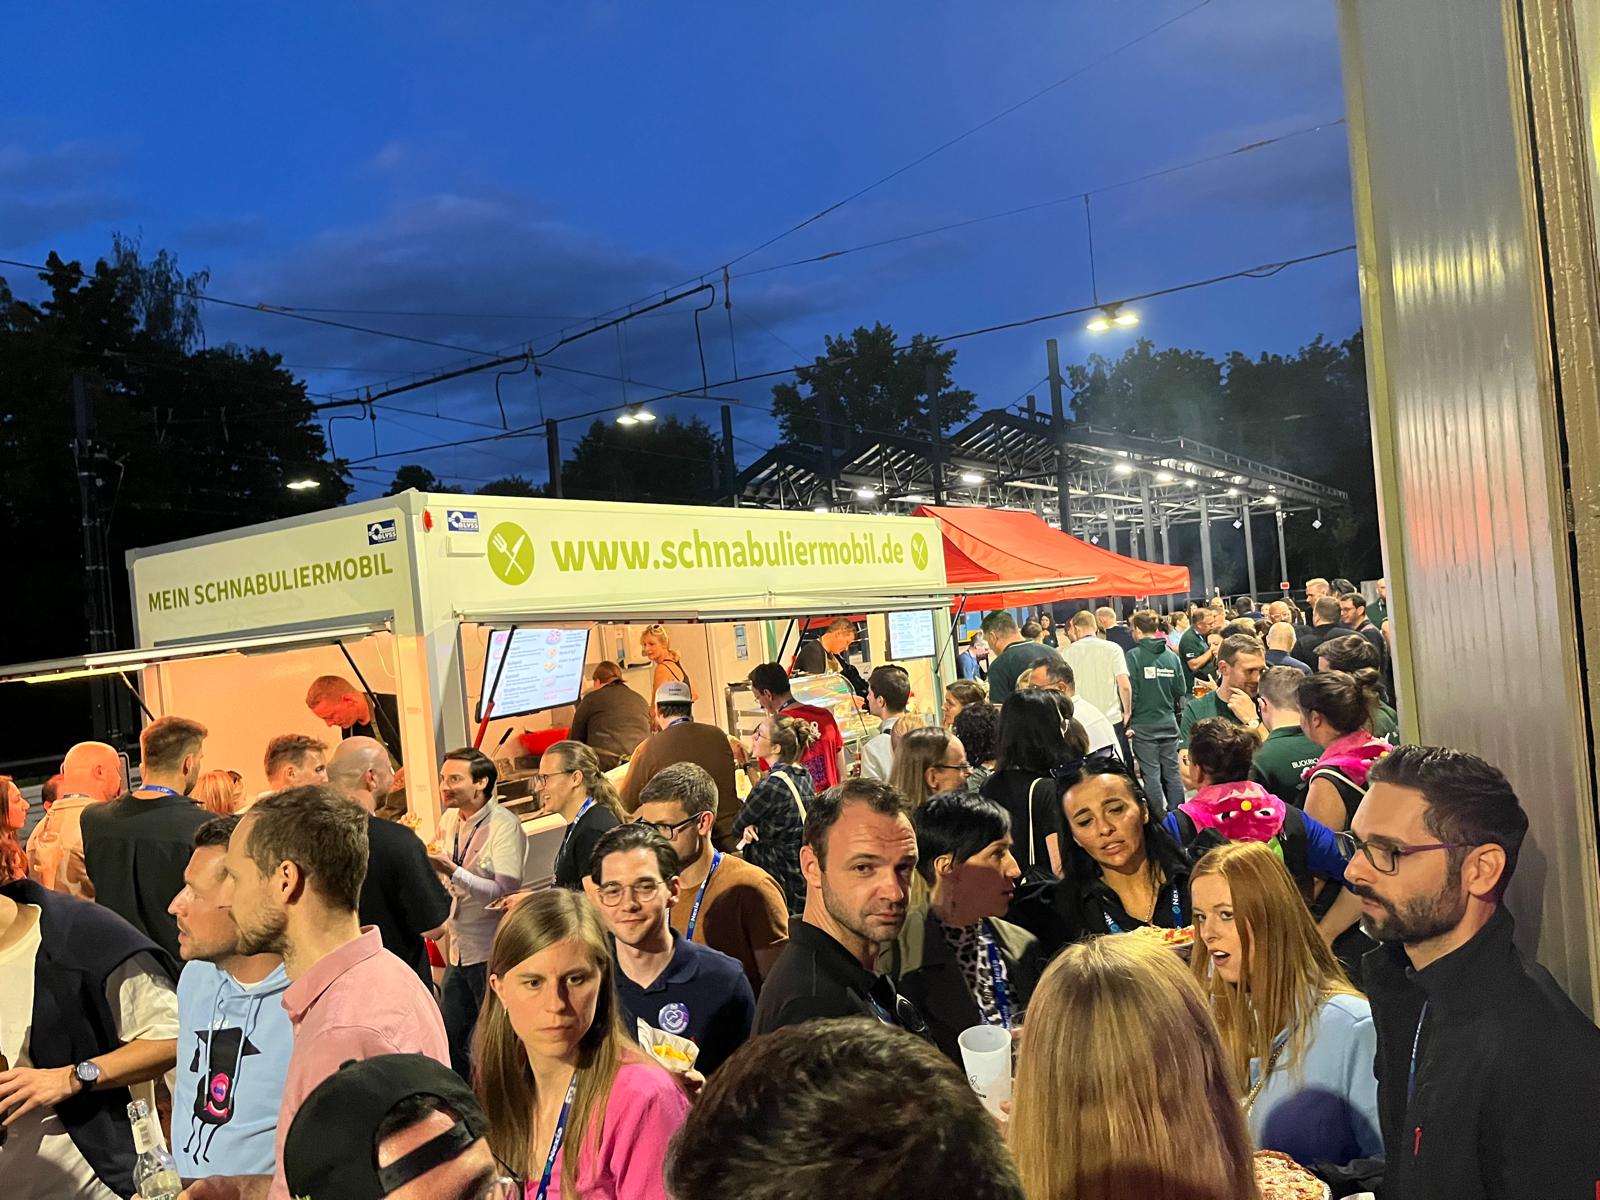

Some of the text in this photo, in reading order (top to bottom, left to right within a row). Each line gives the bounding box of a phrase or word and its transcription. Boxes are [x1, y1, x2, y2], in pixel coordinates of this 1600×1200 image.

[550, 528, 905, 572] www.schnabuliermobil.de
[148, 552, 394, 613] MEIN SCHNABULIERMOBIL
